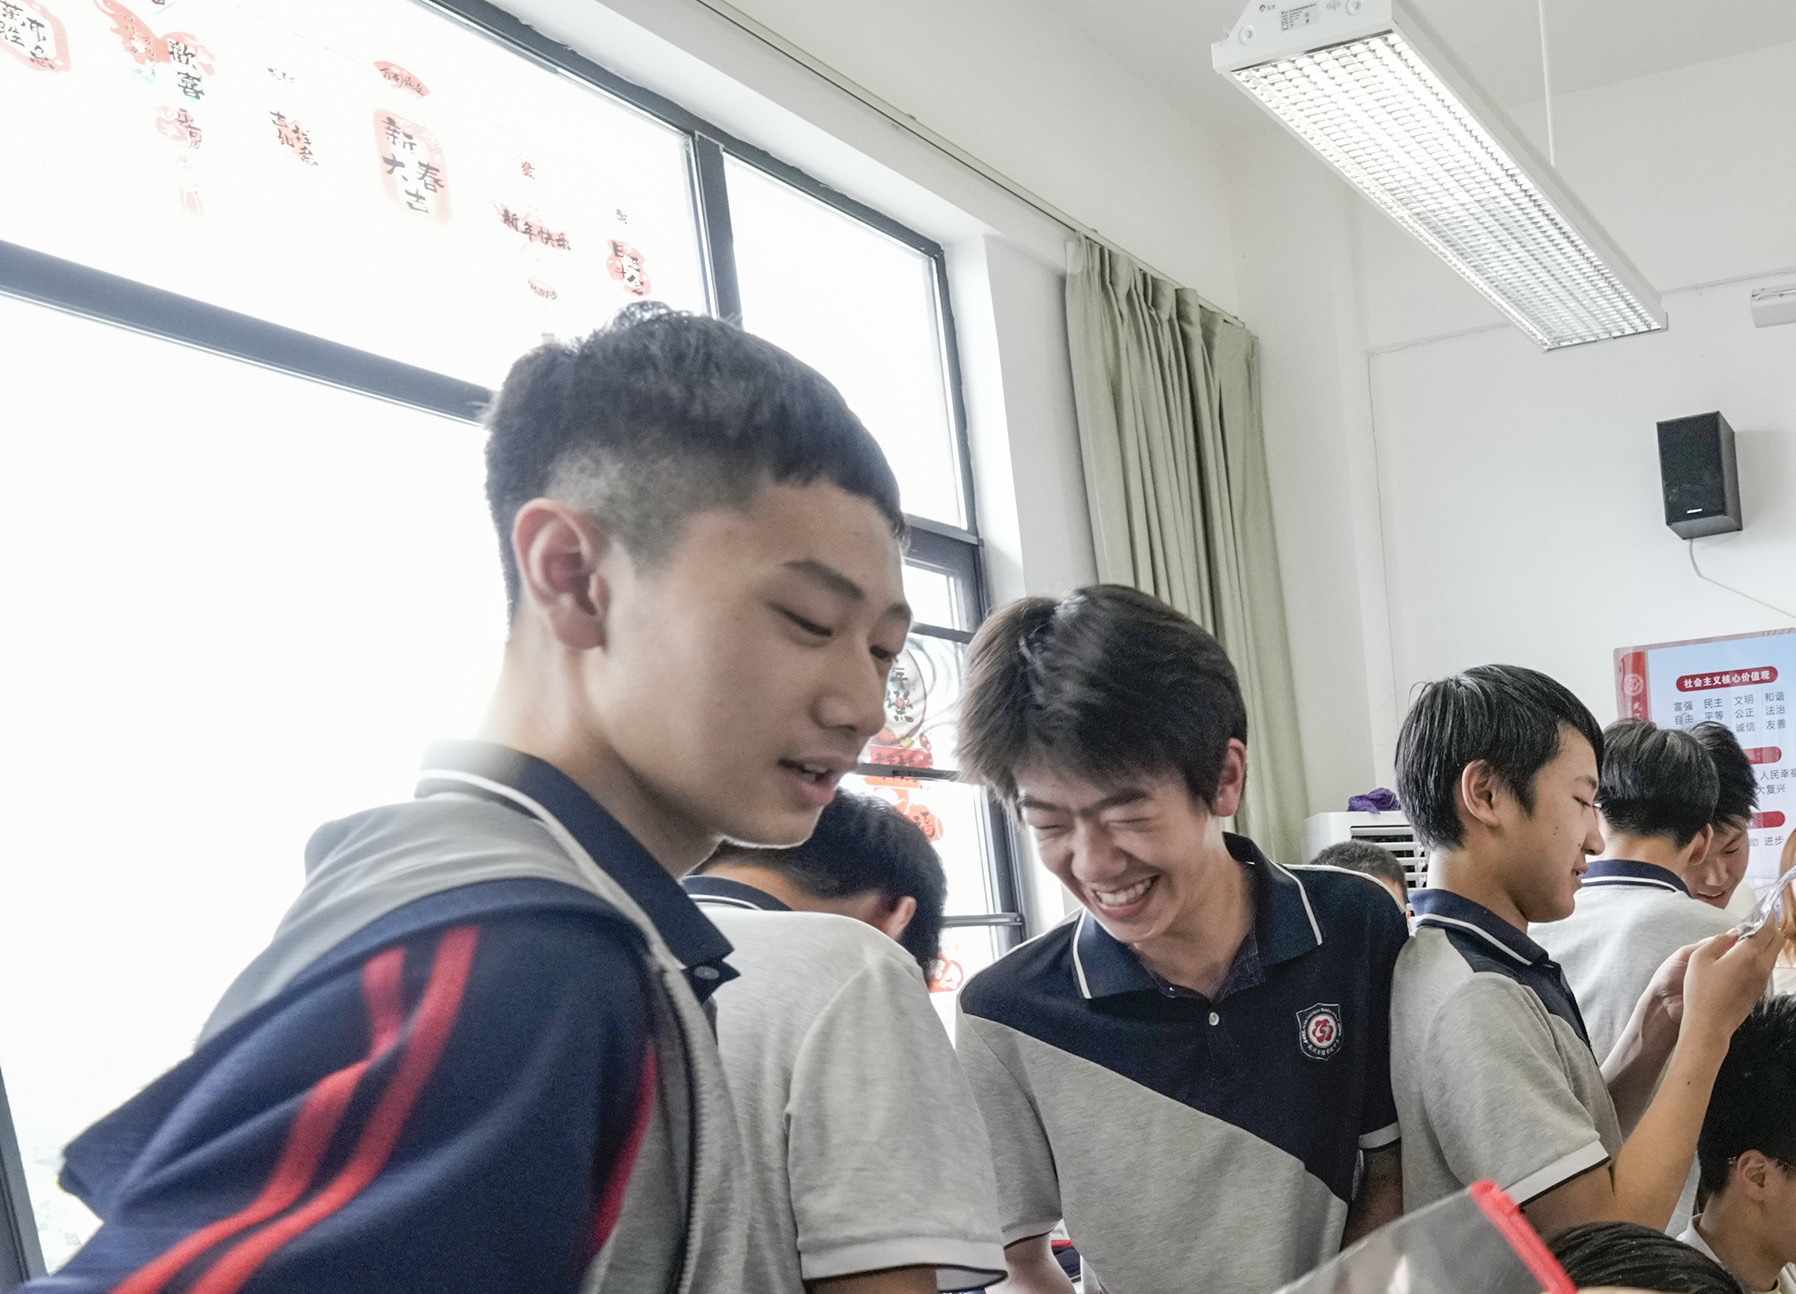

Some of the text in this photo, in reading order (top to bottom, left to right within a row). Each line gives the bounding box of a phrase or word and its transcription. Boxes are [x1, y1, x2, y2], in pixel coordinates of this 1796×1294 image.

[1684, 669, 1771, 689] 社会主义核心价值观
[1673, 691, 1785, 712] 富强 民主 文明 和谐
[1674, 705, 1786, 725] 自由 平等 公正 法治
[1735, 719, 1787, 733] 诚信 友善
